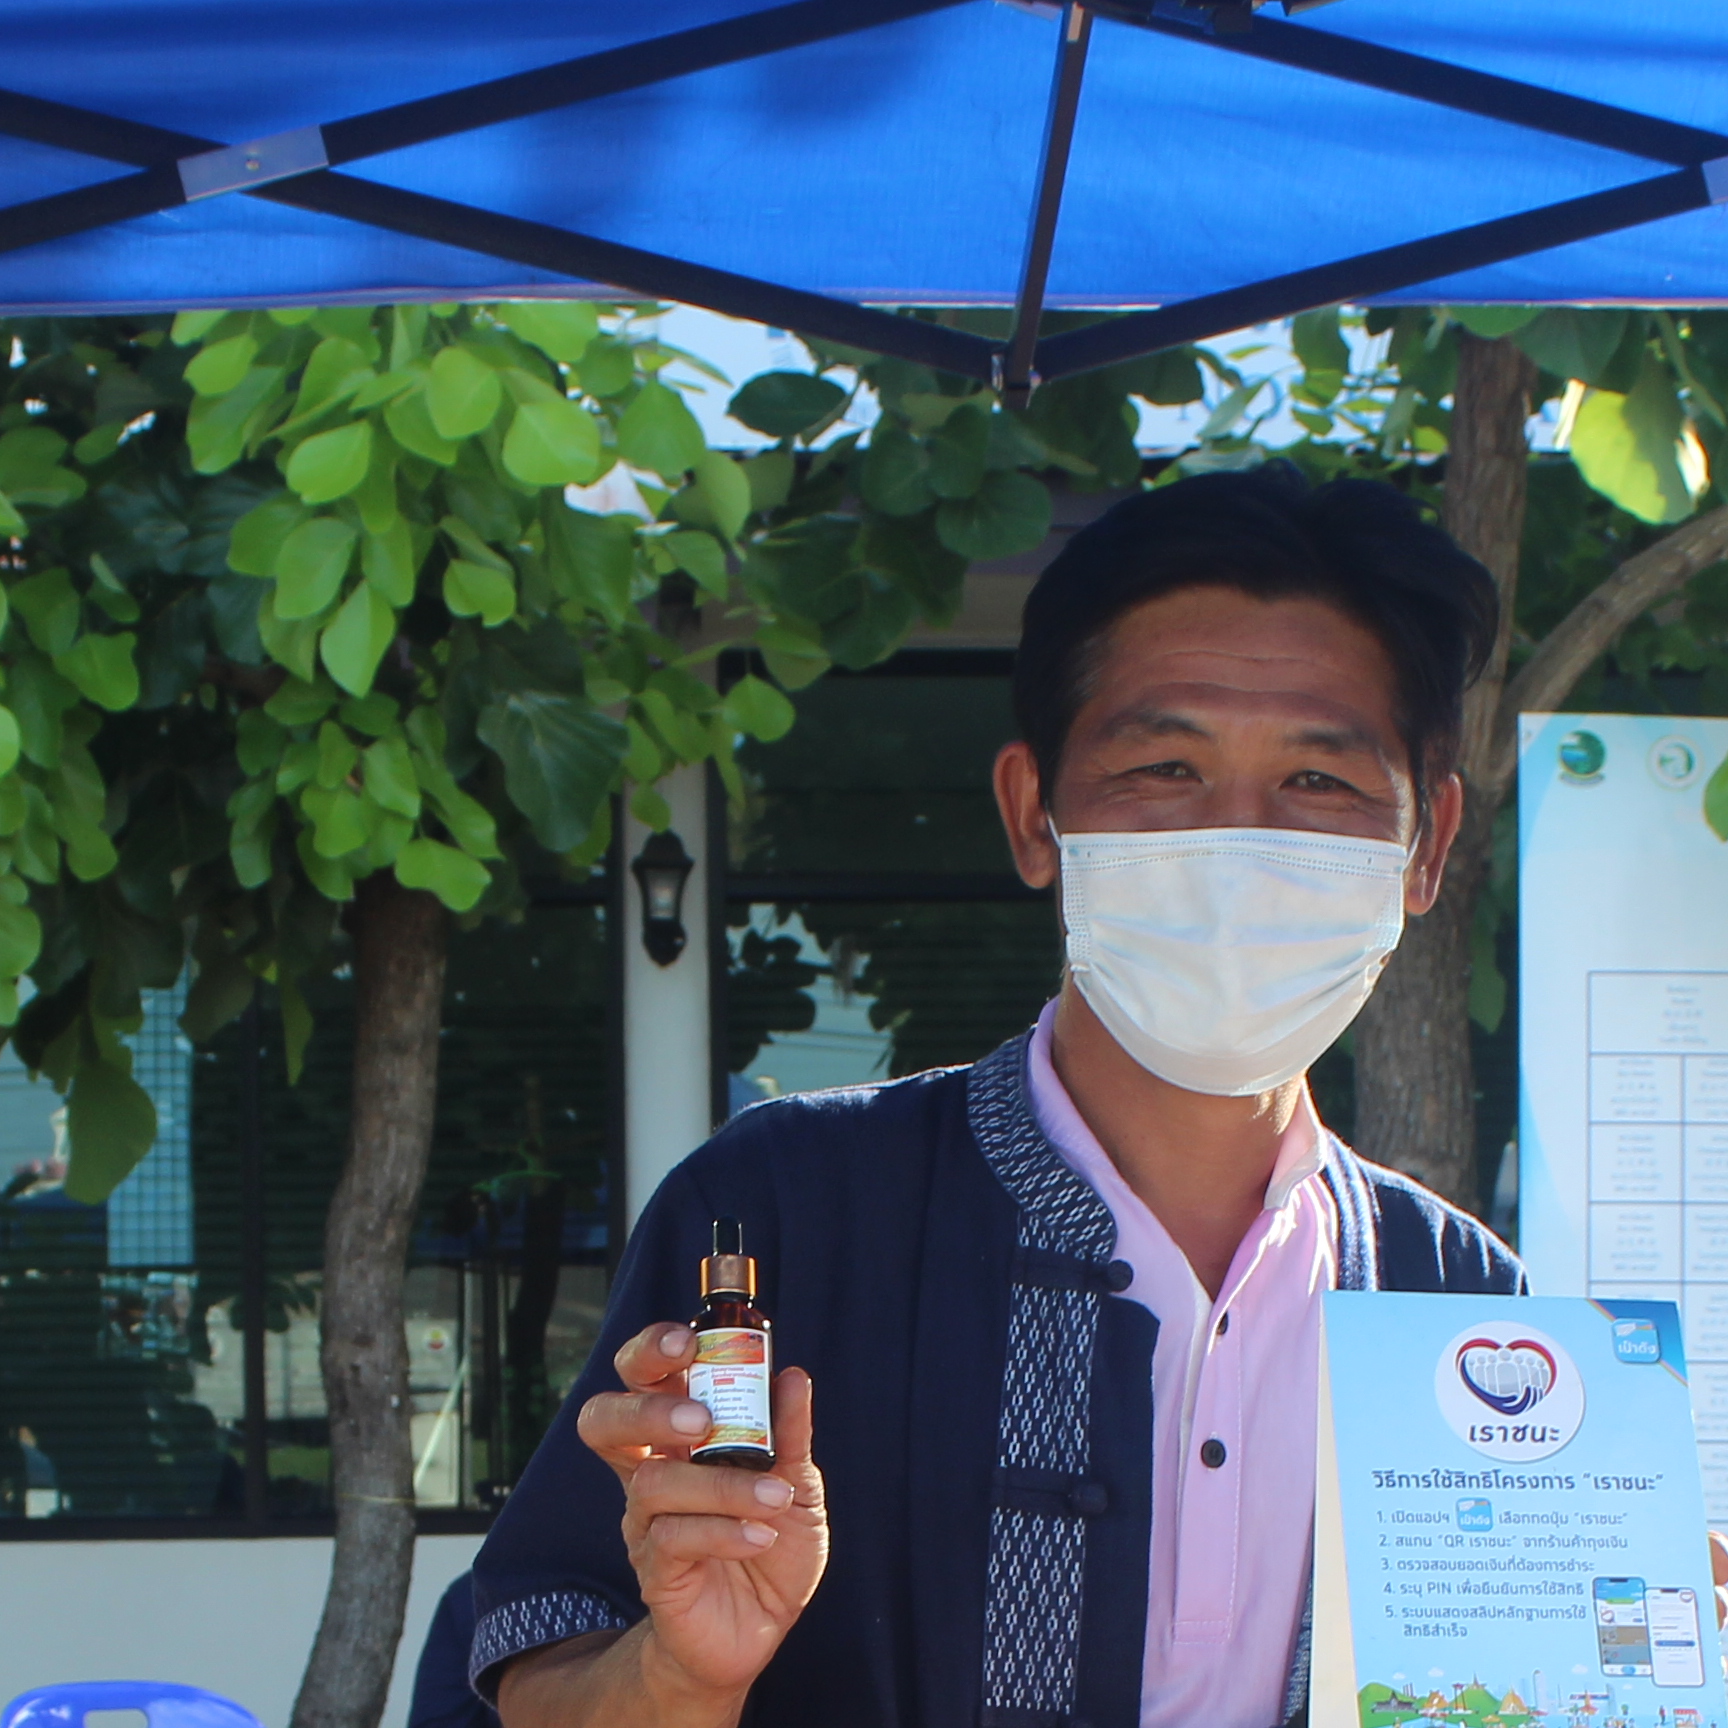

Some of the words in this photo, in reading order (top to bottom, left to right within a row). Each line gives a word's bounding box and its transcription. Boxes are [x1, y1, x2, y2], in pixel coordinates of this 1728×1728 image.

[1469, 1423, 1560, 1444] เราชนะ
[1372, 1468, 1576, 1489] วิธีการใช้สิทธิโครงการ
[1377, 1511, 1387, 1523] 1.
[1379, 1536, 1390, 1548] 2.
[1396, 1536, 1432, 1548] สแกน
[1381, 1558, 1393, 1571] 3.
[1383, 1582, 1395, 1594] 4.
[1400, 1583, 1422, 1598] ระบุ
[1427, 1582, 1451, 1594] PIN
[1385, 1606, 1397, 1618] 5.
